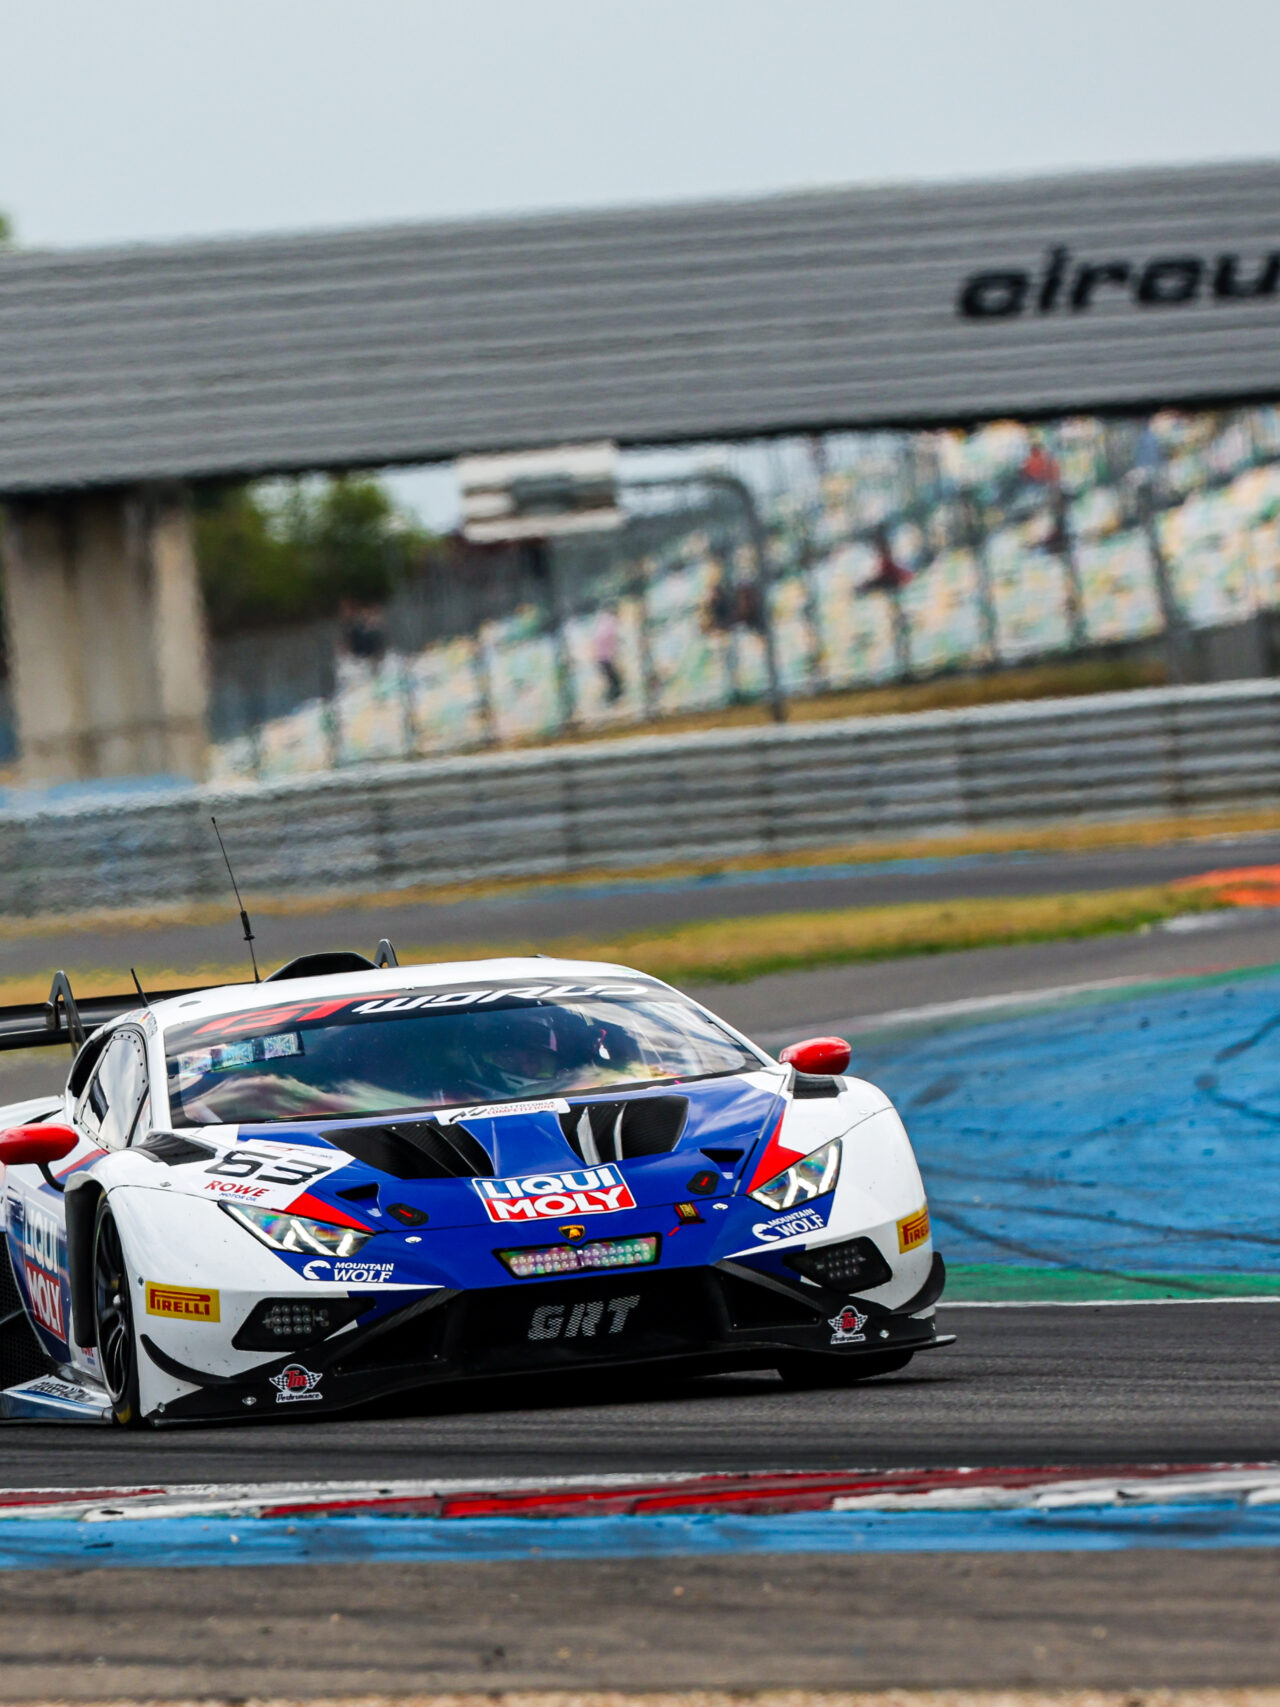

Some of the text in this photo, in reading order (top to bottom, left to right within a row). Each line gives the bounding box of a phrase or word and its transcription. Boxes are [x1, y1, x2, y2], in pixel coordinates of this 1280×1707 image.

[352, 985, 648, 1014] WORLD
[204, 1180, 270, 1198] ROWE
[219, 1192, 245, 1200] MOTOR
[482, 1167, 617, 1199] LIQUI
[492, 1186, 624, 1219] MOLY
[767, 1207, 816, 1226] MOUNTAIN
[25, 1205, 58, 1274] LIQUI
[775, 1214, 824, 1237] WOLF
[333, 1268, 393, 1283] WOLF
[334, 1262, 395, 1271] MOUNTAIN
[26, 1266, 62, 1333] MOLY
[150, 1288, 211, 1316] PIRELLI
[527, 1294, 640, 1341] GRT
